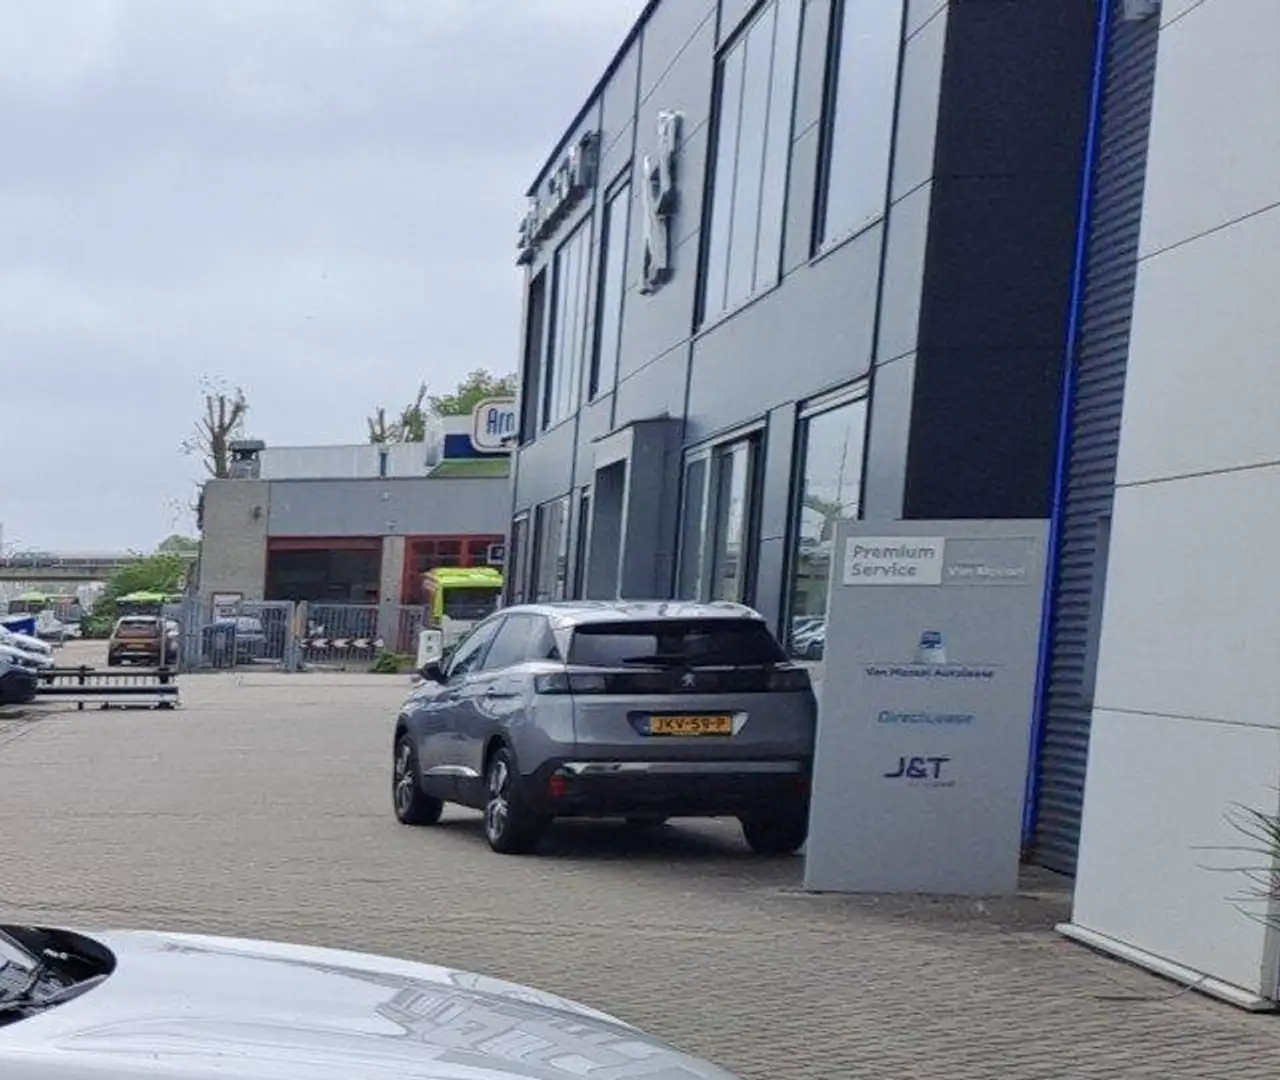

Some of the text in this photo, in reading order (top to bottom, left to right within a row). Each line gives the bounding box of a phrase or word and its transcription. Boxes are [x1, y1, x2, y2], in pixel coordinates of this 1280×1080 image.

[852, 544, 935, 560] Premium
[851, 562, 917, 578] Service
[883, 756, 952, 779] J&T
